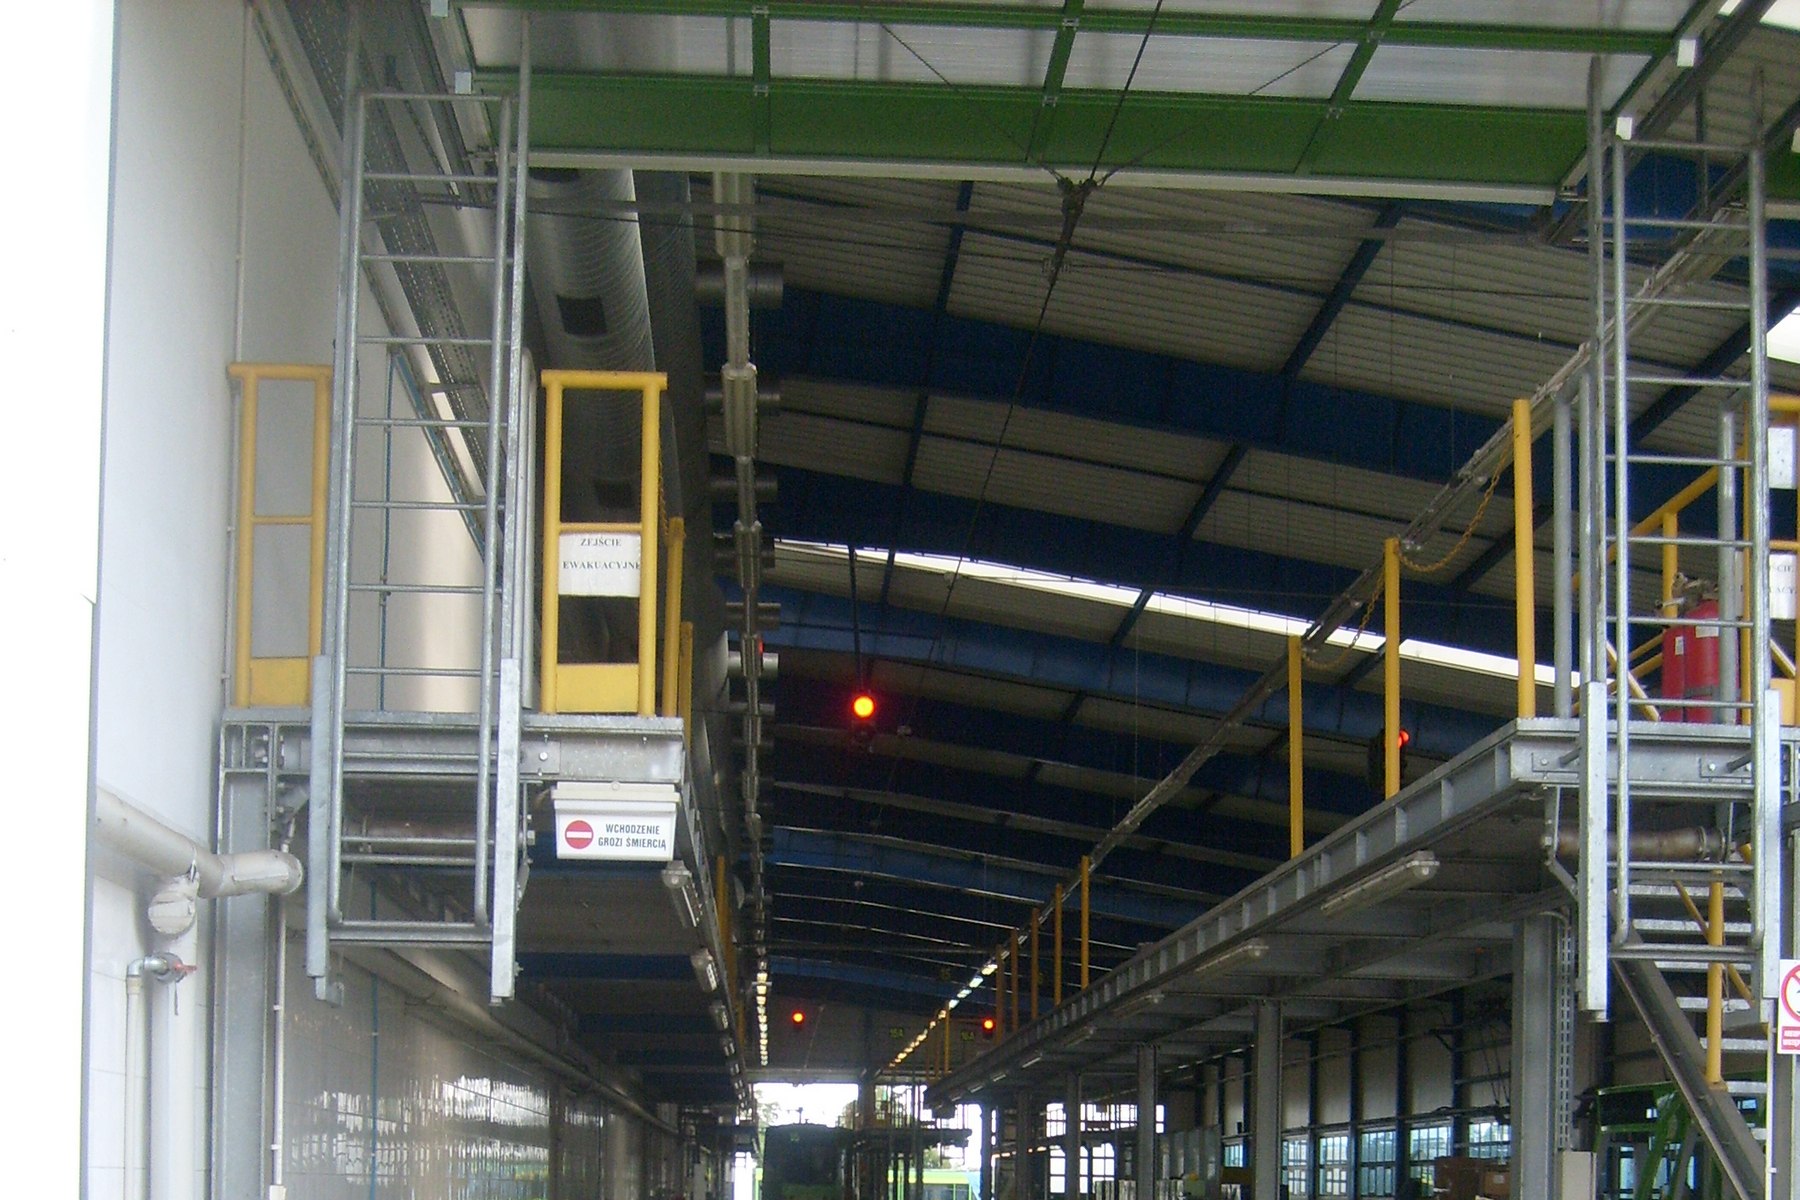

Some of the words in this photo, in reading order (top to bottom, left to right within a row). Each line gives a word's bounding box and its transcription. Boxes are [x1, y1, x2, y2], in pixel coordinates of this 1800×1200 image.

[605, 823, 660, 835] WCHODZENIE
[598, 838, 622, 847] GROZI
[626, 837, 667, 851] ŚMIERCIĄ
